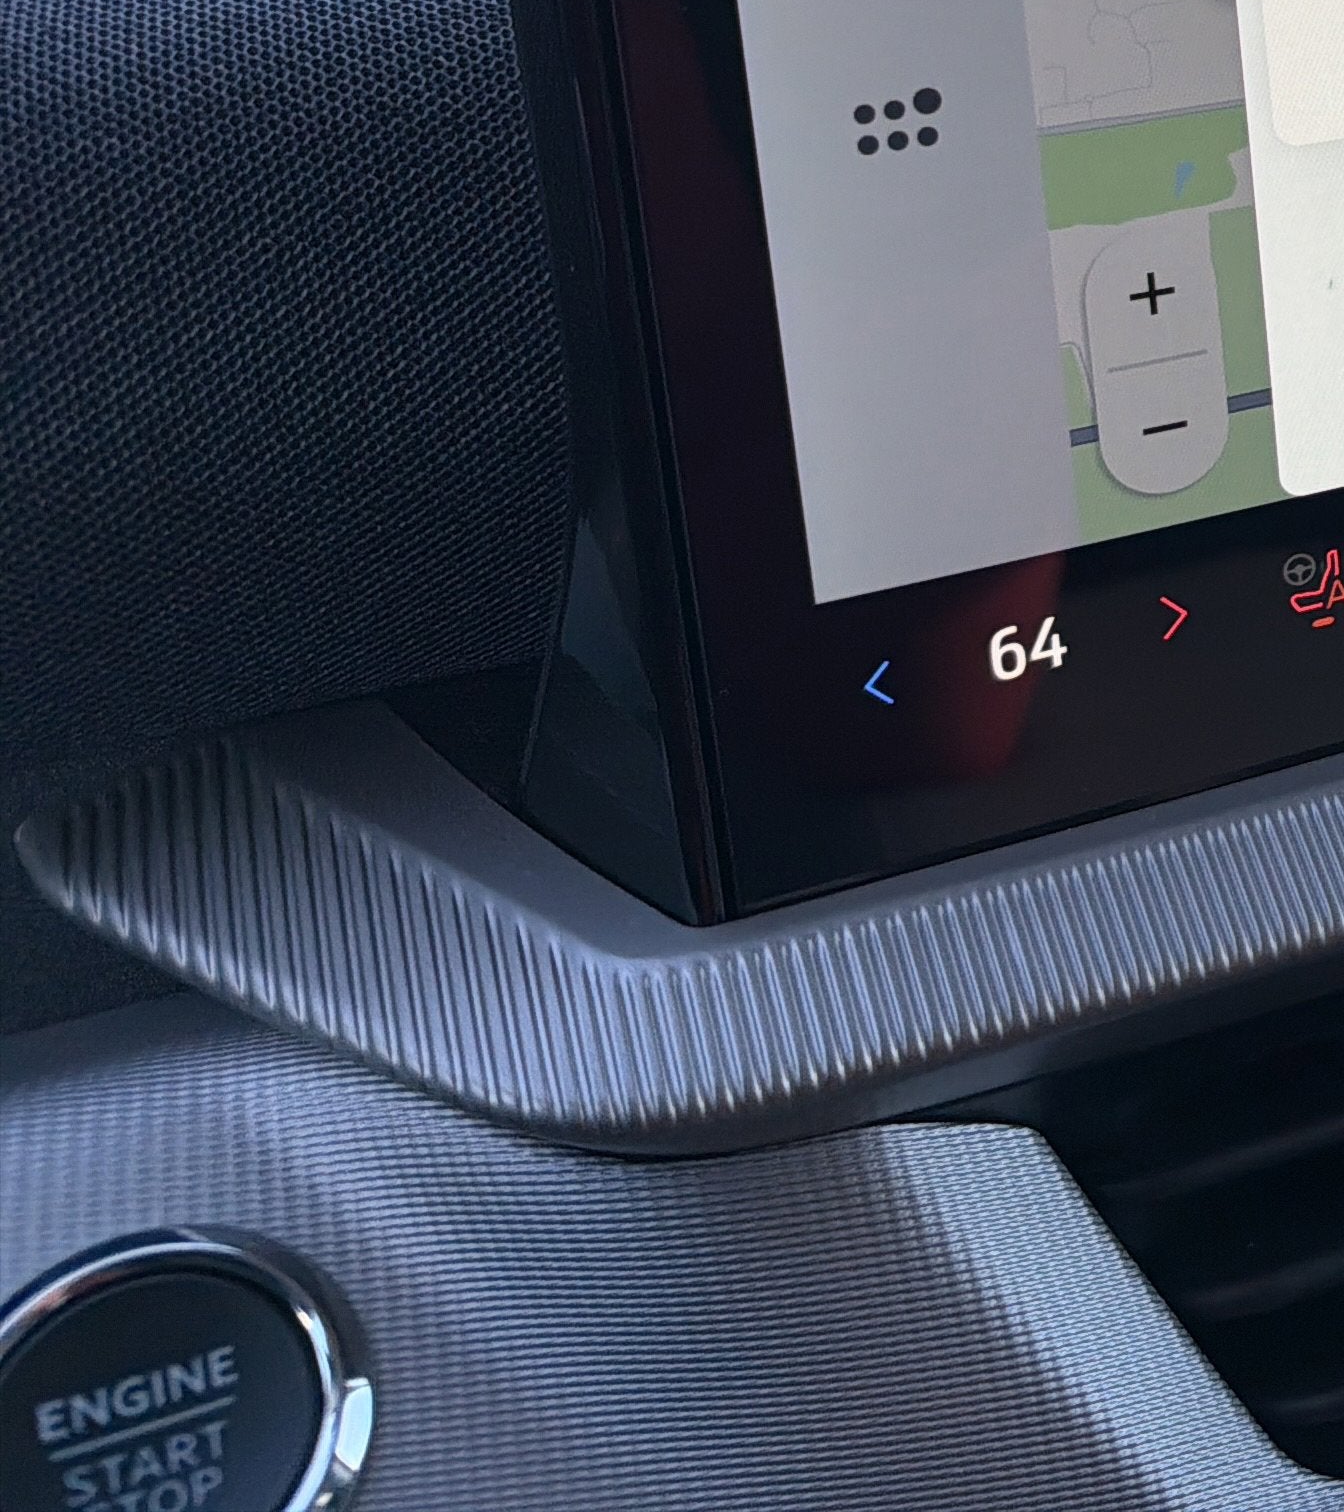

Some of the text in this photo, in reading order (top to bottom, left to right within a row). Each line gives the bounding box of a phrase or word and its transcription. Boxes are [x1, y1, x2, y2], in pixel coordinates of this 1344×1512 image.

[987, 616, 1069, 682] 64
[35, 1345, 239, 1442] ENGINE
[63, 1421, 227, 1509] START
